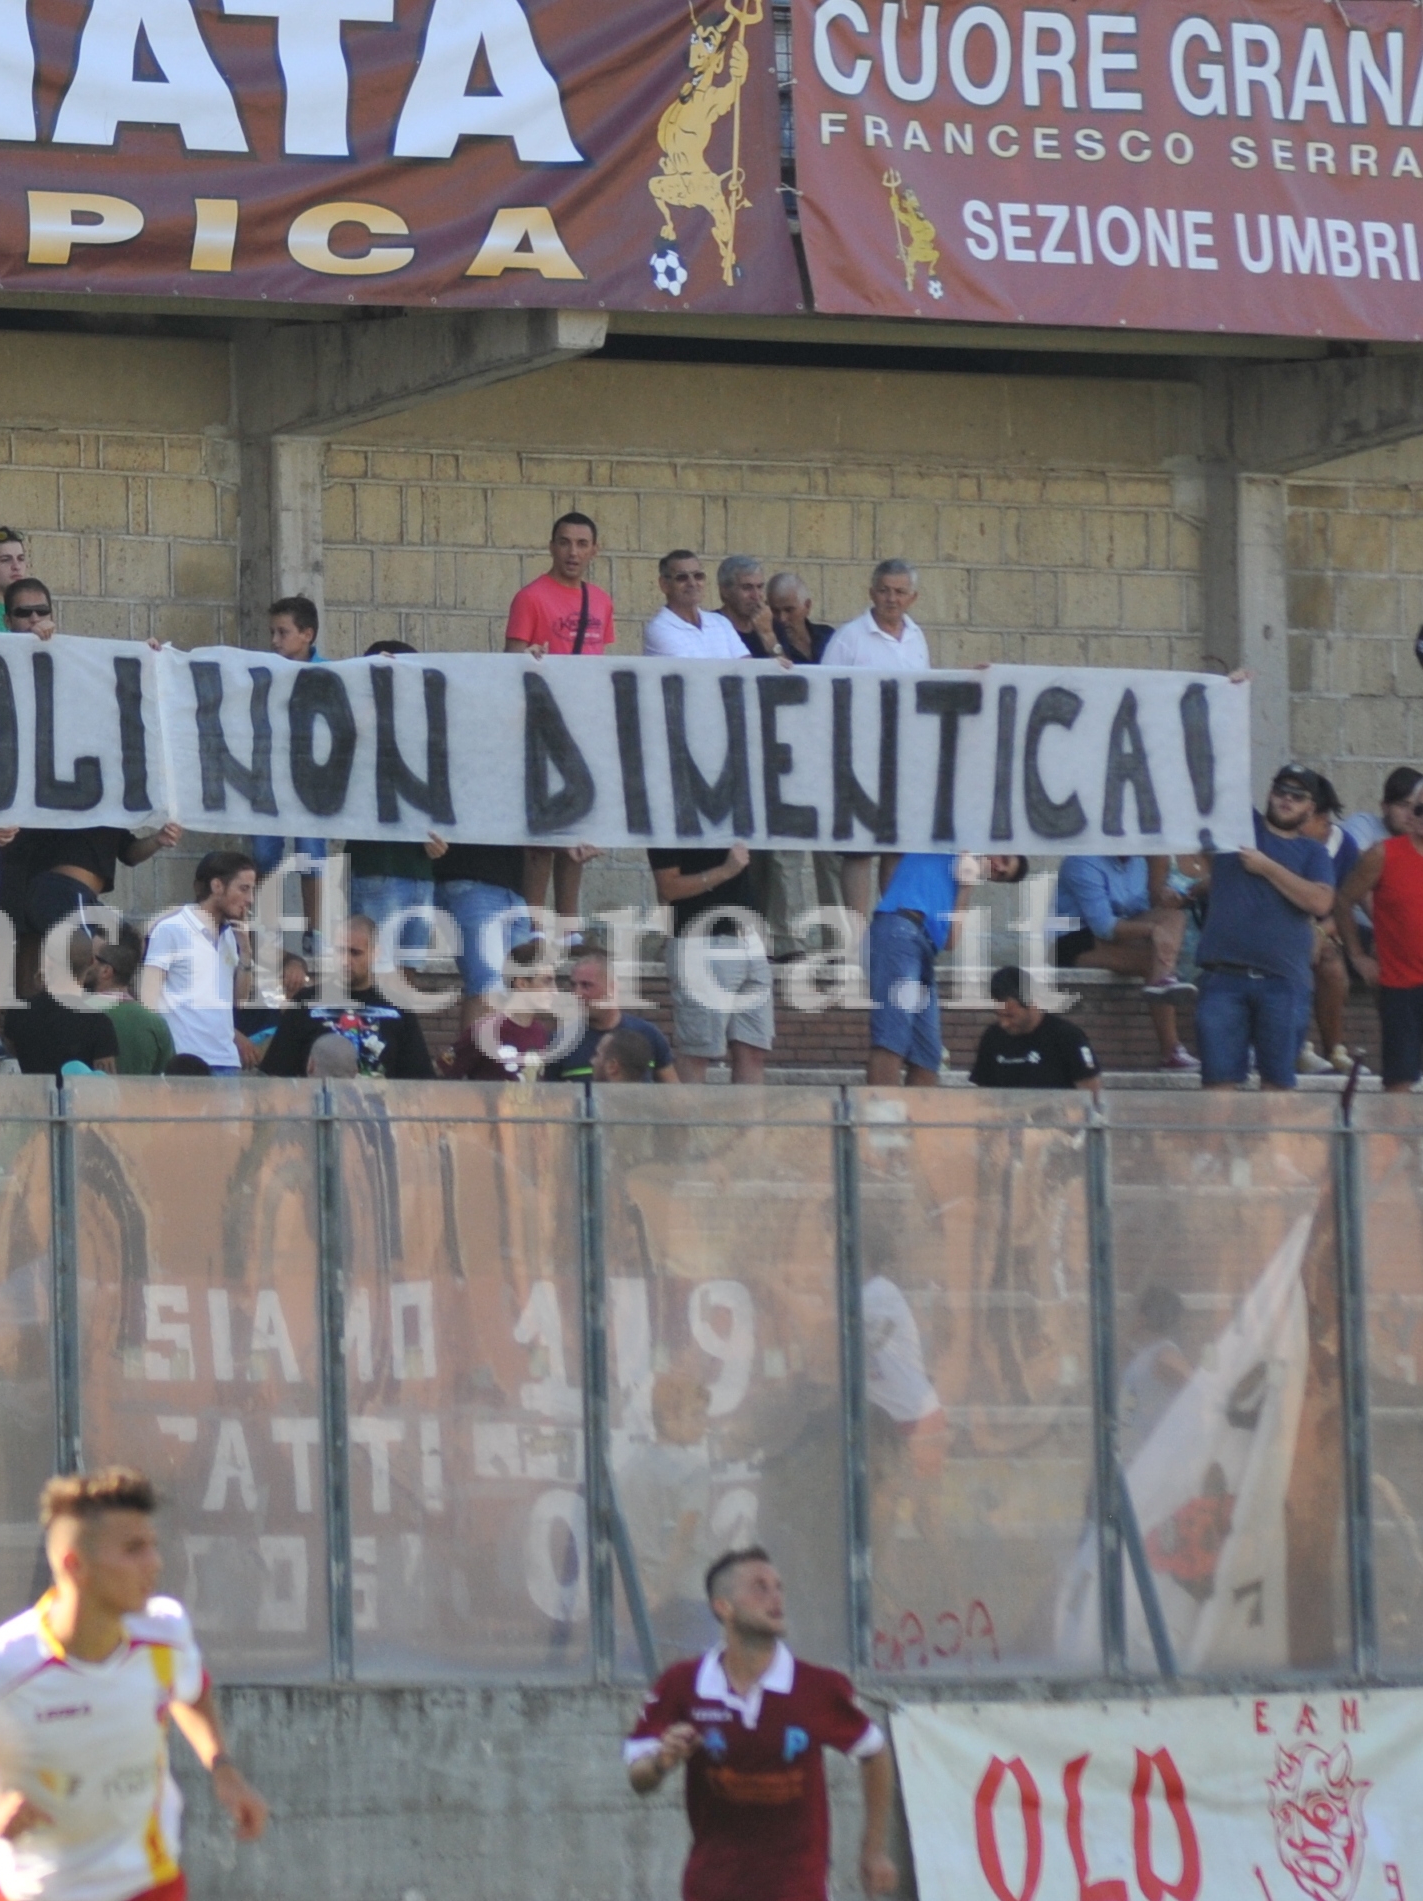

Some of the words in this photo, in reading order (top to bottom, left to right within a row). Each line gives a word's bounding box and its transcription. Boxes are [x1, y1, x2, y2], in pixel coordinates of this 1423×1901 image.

[812, 0, 1144, 111] CUORE
[1170, 16, 1423, 127] GRAN
[819, 112, 1195, 166] FRANCESCO
[963, 199, 1220, 272] SEZIONE
[189, 660, 458, 827] NON
[523, 669, 1216, 853] DIMENTICA!
